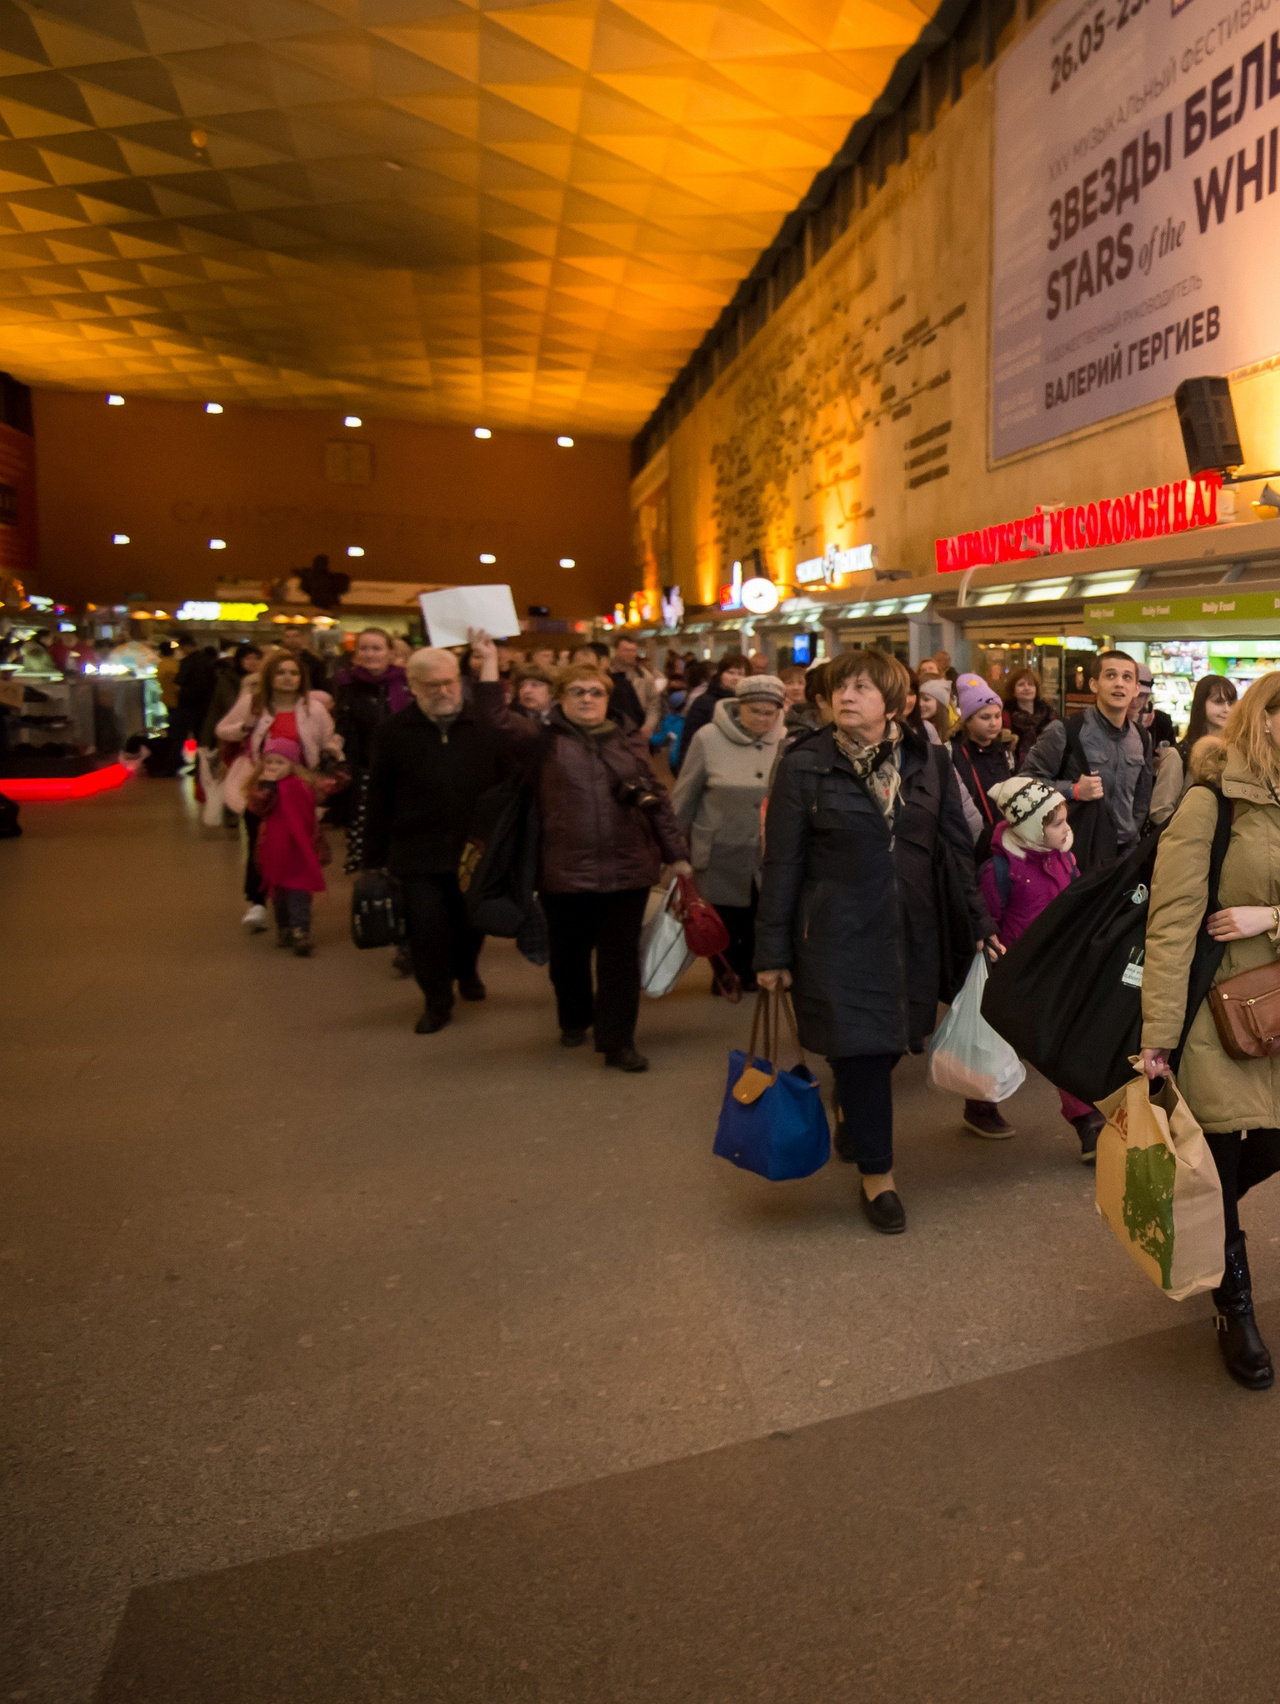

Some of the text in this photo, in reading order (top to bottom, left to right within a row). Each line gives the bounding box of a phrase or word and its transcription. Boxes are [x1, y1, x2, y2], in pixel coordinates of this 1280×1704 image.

[1181, 0, 1277, 74] ФЕСТИВАЛ
[1047, 111, 1173, 251] ЗВЕЗДЫ
[1046, 222, 1134, 321] STARS
[1138, 225, 1159, 277] of
[1159, 215, 1186, 259] the
[1045, 341, 1123, 410] ВАЛЕРИЙ
[1127, 304, 1220, 376] ГЕРГИЕВ
[1049, 476, 1223, 554] МЯСОКОМБИНАТ
